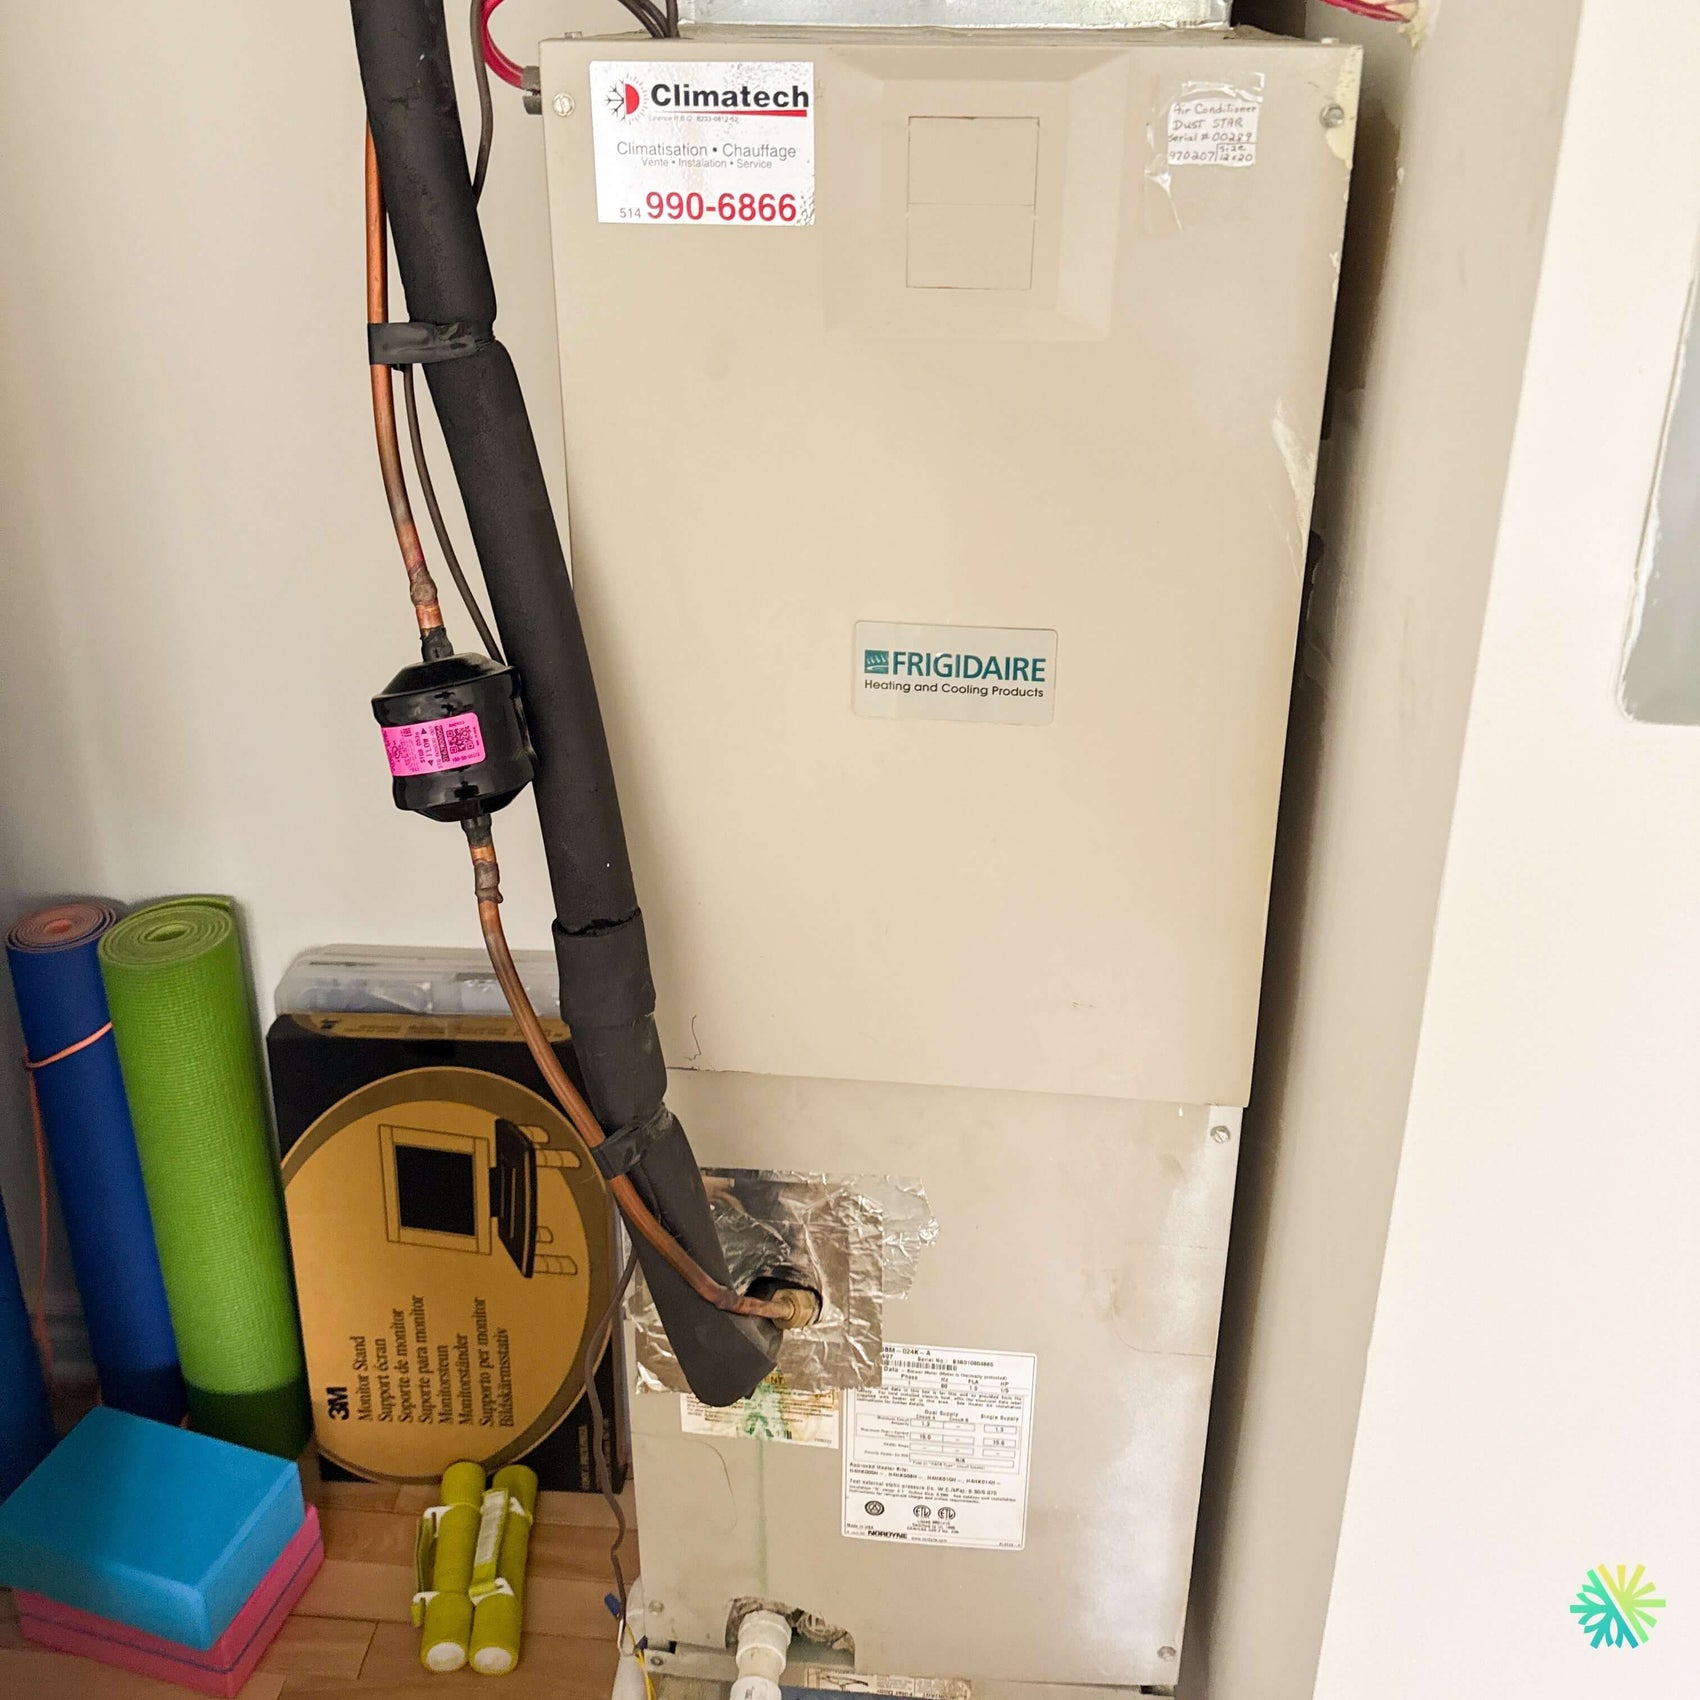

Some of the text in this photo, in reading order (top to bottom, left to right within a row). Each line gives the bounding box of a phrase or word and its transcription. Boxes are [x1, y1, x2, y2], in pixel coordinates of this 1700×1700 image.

[651, 83, 809, 108] Climatech
[1173, 103, 1257, 115] Air Conditioner
[1212, 117, 1244, 129] STAR
[617, 142, 796, 161] Climatisation Chauffage
[641, 157, 772, 169] Vente Instalation Service
[619, 191, 797, 222] 514 990-6866
[893, 651, 1046, 682] FRIGIDAIRE
[864, 680, 1044, 698] Heating and Cooling Products
[390, 1308, 416, 1423] Soporte de monitor
[410, 1295, 437, 1424] Suporte para monitor
[471, 1297, 497, 1427] Supporto per monitor
[351, 1336, 373, 1421] Monitor Stand
[437, 1345, 453, 1424] Monitorsteun
[326, 1386, 349, 1421] 3M
[377, 1375, 396, 1422] Support
[867, 1530, 907, 1540] NORDYNE
